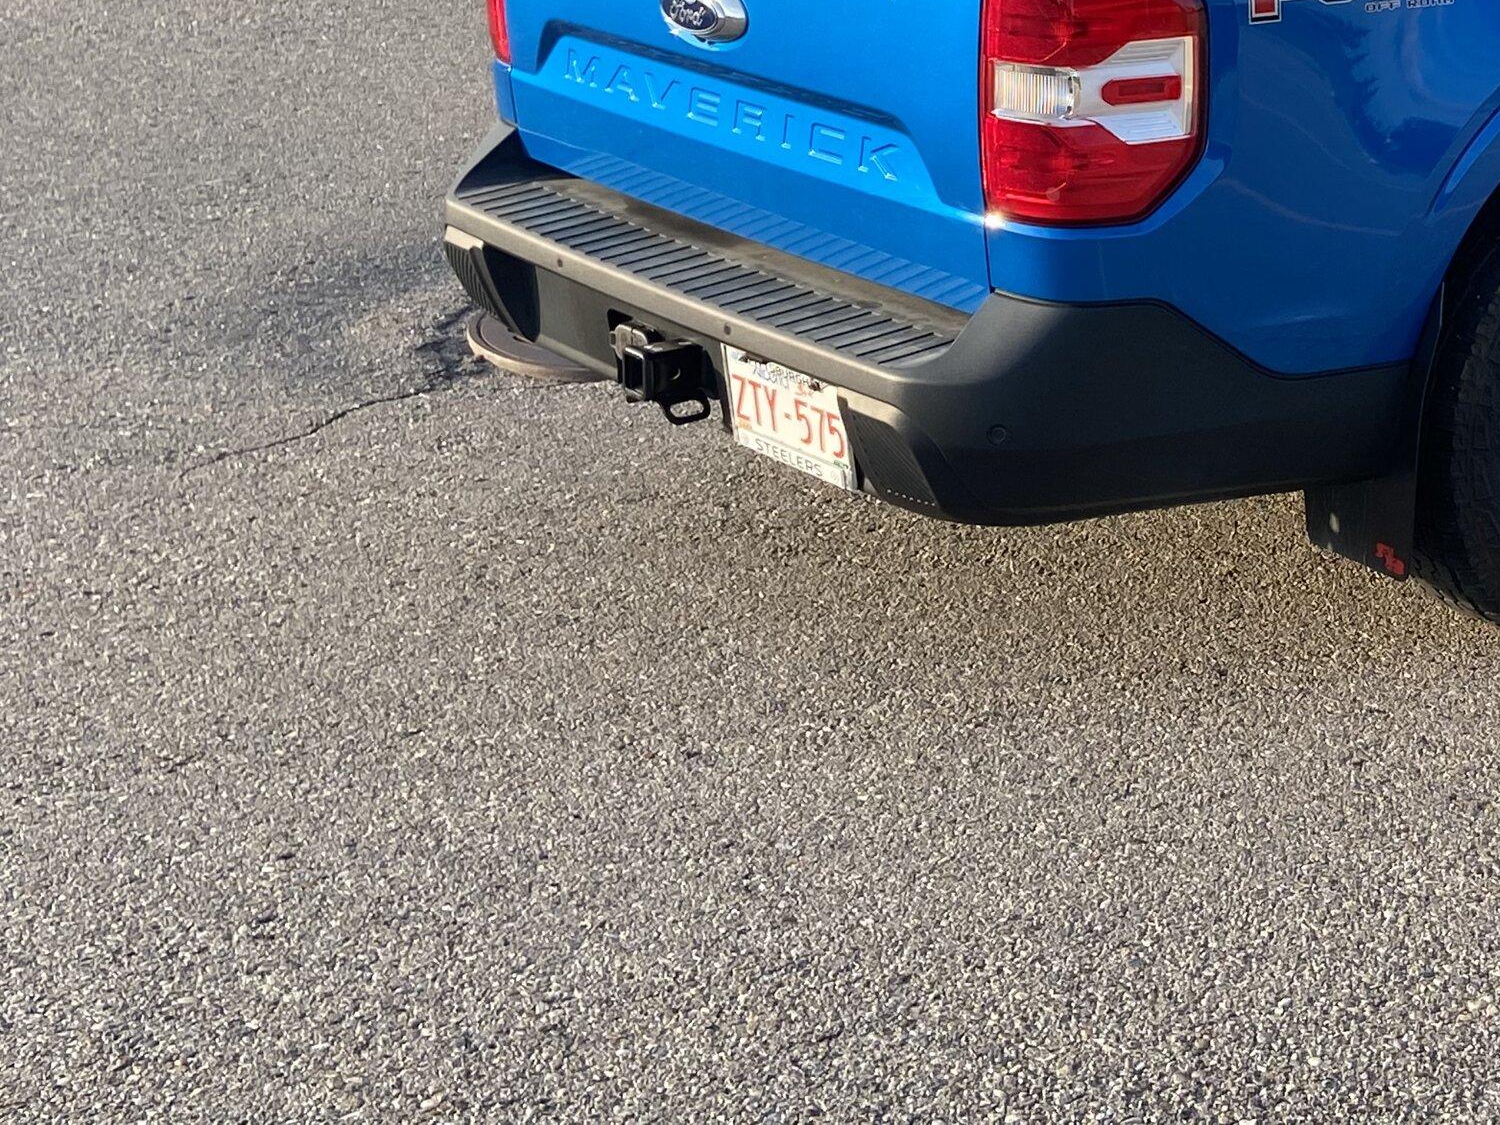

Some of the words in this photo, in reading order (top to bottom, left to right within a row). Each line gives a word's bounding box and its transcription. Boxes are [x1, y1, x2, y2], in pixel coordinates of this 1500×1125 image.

[1364, 0, 1401, 13] OFF
[564, 47, 900, 182] MAVERICK
[731, 373, 846, 459] ZTY-575
[754, 437, 824, 477] STEELERS
